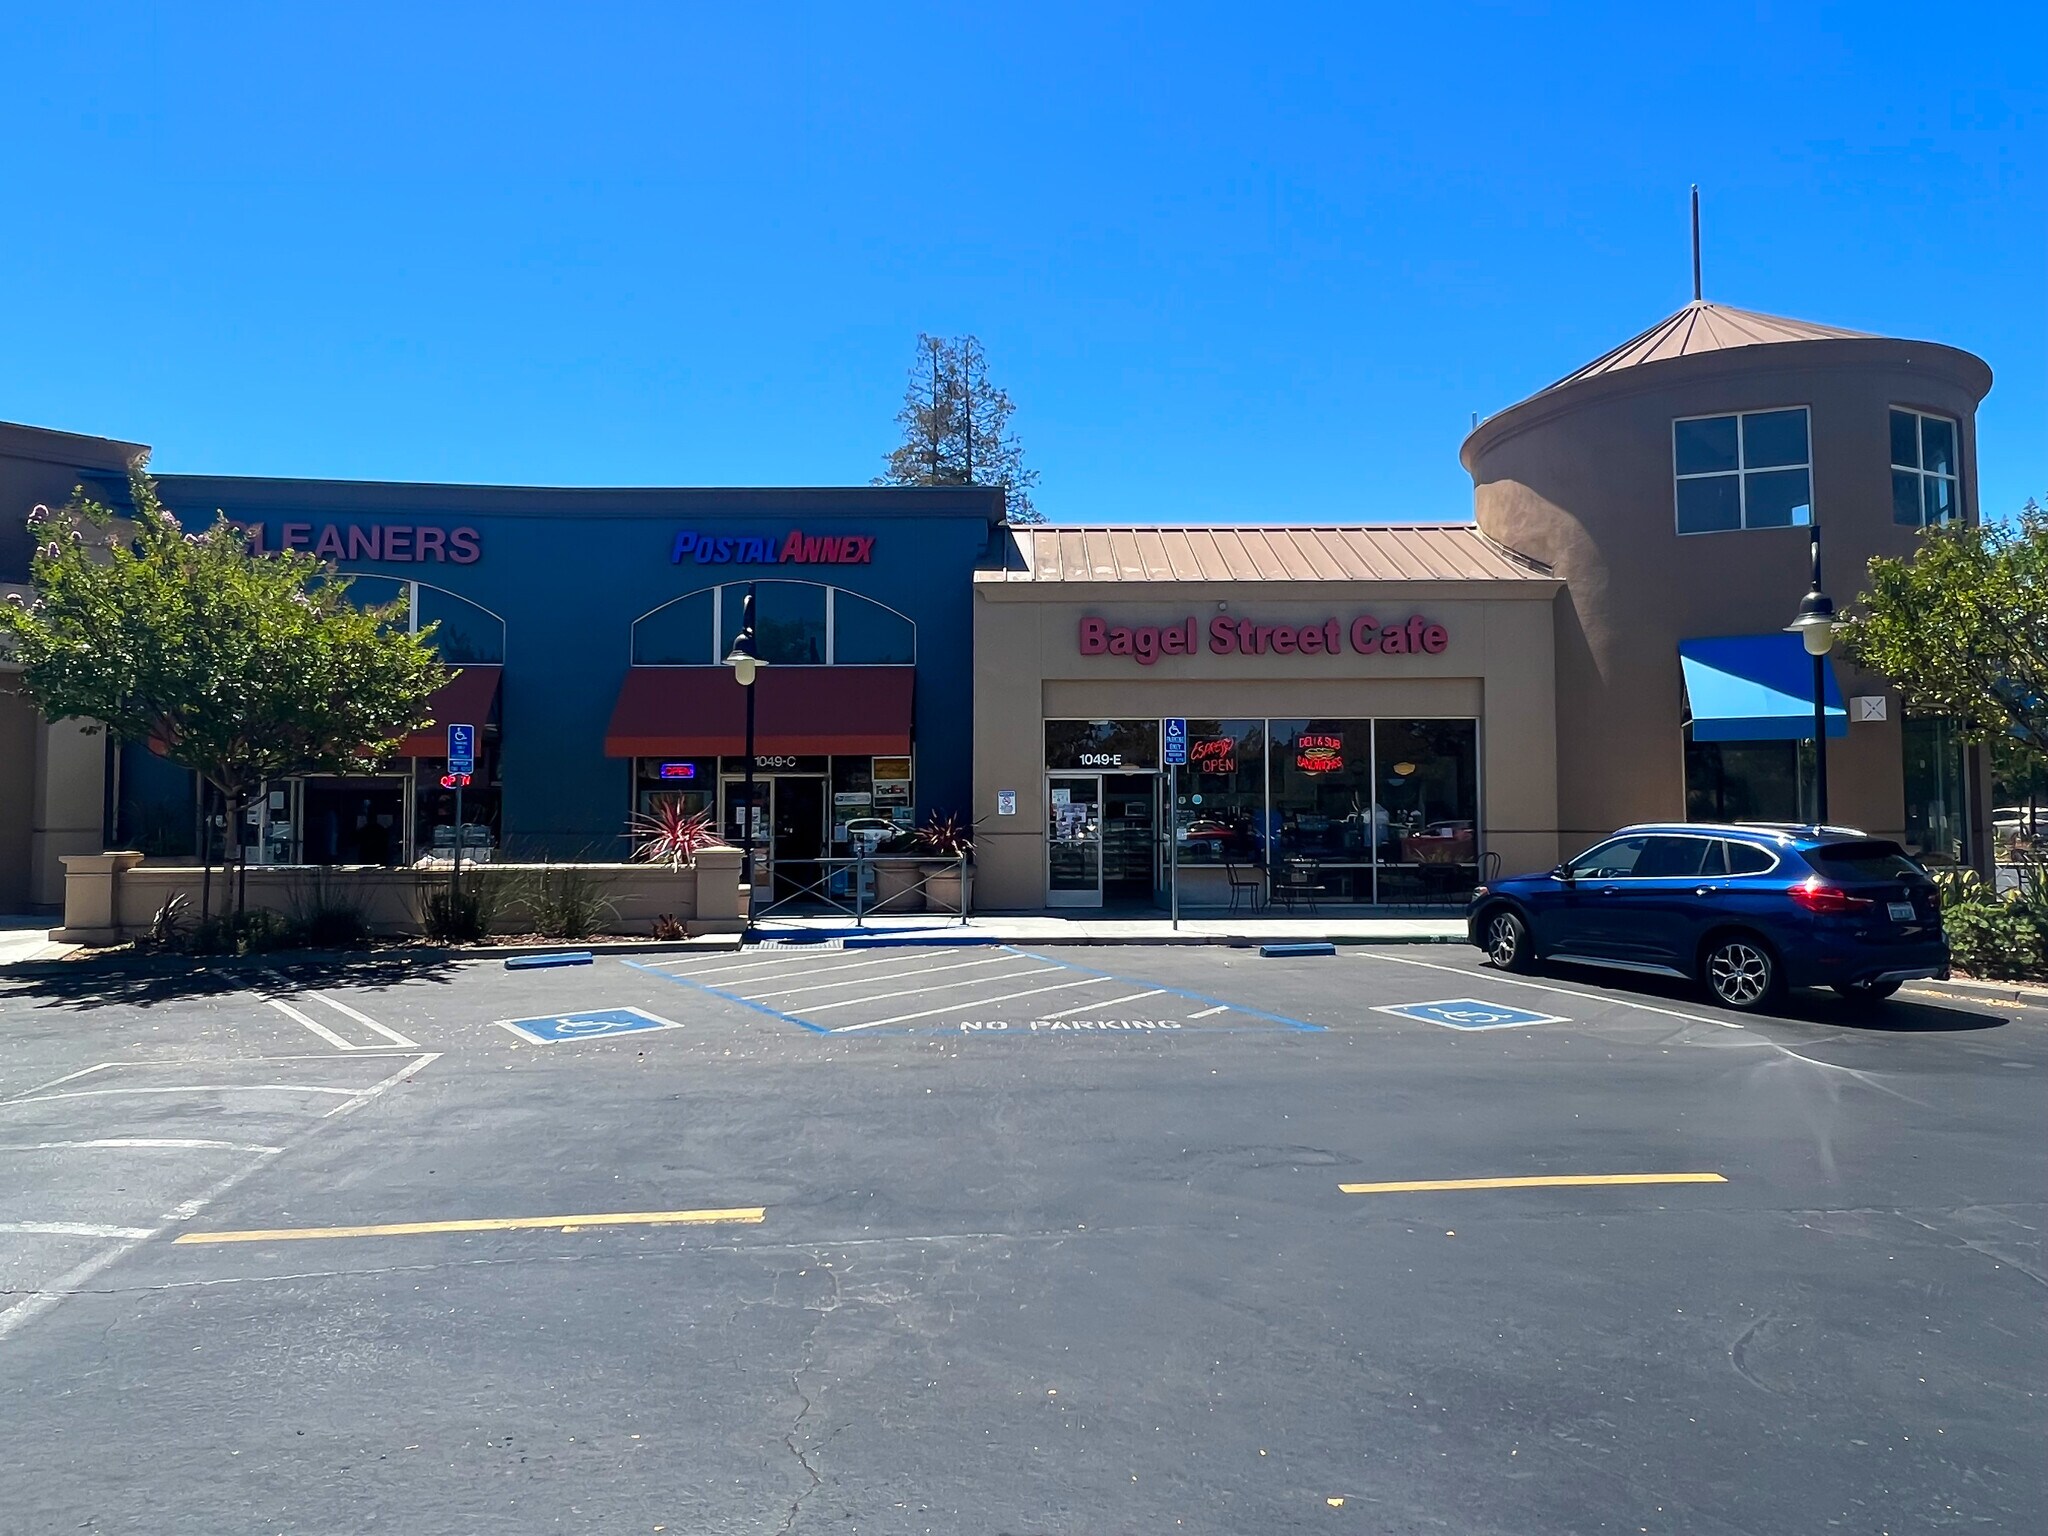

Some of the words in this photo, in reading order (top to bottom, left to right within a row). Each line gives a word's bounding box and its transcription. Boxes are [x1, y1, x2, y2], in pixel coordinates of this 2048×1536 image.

[228, 520, 481, 565] LEANERS
[1080, 616, 1198, 666] Bagel
[1209, 615, 1342, 655] Street
[1350, 614, 1449, 655] Cafe
[754, 755, 797, 767] 1049-C
[1079, 753, 1122, 766] 1049-E
[1202, 758, 1234, 772] OPEN
[665, 766, 690, 776] OPEN
[960, 1020, 1008, 1031] NO
[1030, 1020, 1182, 1031] PARKING
